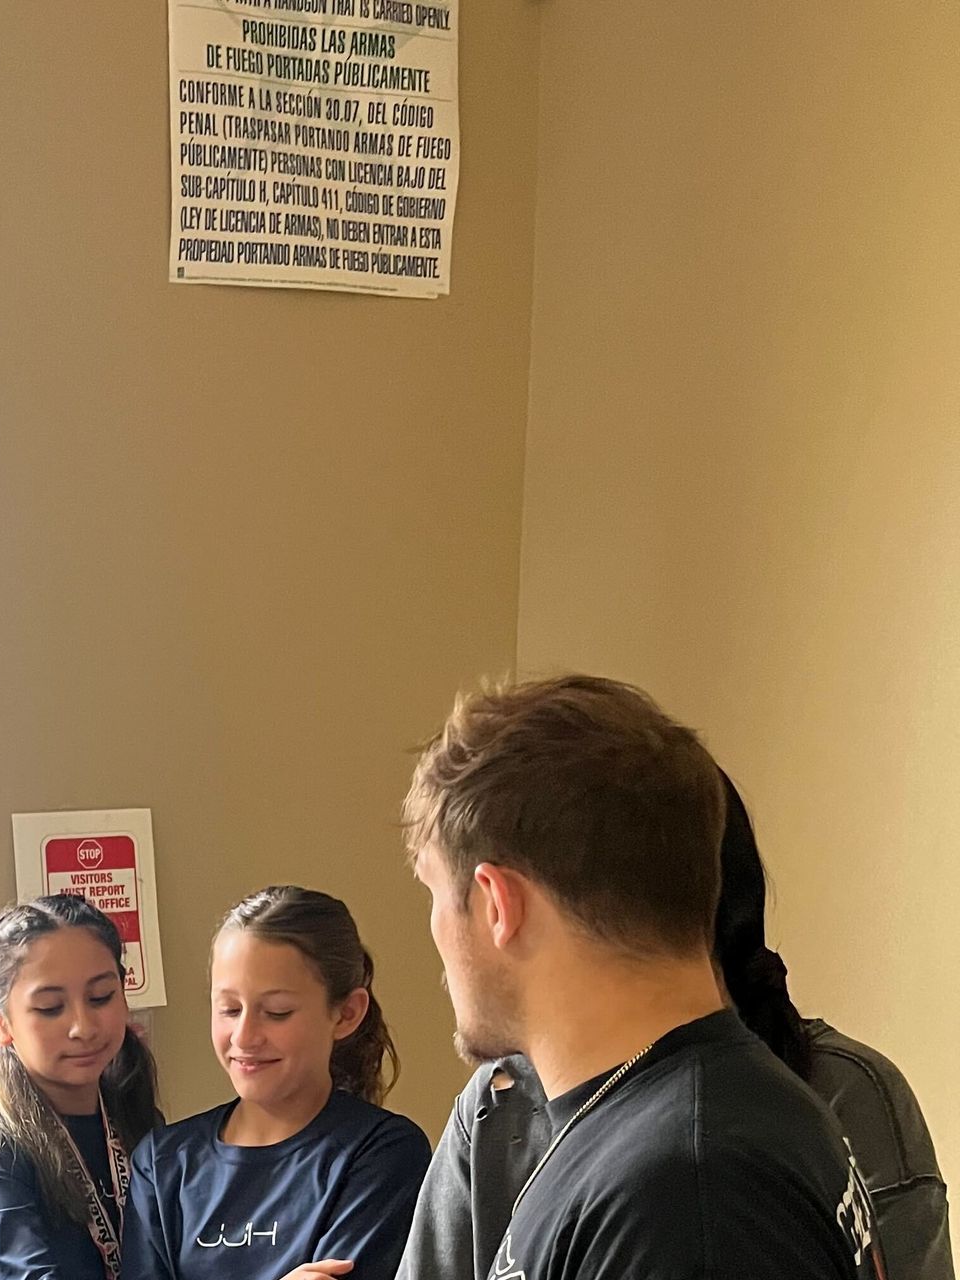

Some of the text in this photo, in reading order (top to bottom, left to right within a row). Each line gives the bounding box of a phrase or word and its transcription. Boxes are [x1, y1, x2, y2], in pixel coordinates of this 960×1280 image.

[360, 0, 370, 18] IS
[373, 0, 413, 24] CARRIED
[242, 19, 396, 59] PROHIBIDAS LAS ARMAS
[206, 43, 430, 93] DE FUEGO PORTADAS PÚBLICAMENTE
[179, 78, 434, 129] CONFORME A LA SECCIÓN 30.07, DEL CÓDIGO
[179, 111, 452, 160] PENAL (TRASPASAR PORTANDO ARMAS DE FUEGO
[180, 136, 447, 190] PÚBLICAMENTE) PERSONAS CON LICENCIA BAJO DEL
[180, 171, 446, 221] SUB-CAPÍTULO H, CAPÍTULO 411, CÓDIGO DE GOBIERNO
[180, 206, 203, 232] (LEY
[204, 207, 217, 231] DE
[220, 209, 266, 234] LICENCIA
[269, 212, 282, 235] DE
[326, 217, 340, 241] NO
[341, 219, 370, 244] DEBEN
[372, 222, 408, 247] ENTRAR
[410, 225, 418, 248] A
[419, 226, 441, 250] ESTA
[178, 238, 234, 264] PROPIEDAD
[237, 241, 291, 267] PORTANDO
[292, 244, 327, 269] ARMAS
[329, 247, 341, 270] DE
[342, 249, 369, 273] FUEGO
[79, 848, 101, 860] STOP
[70, 873, 113, 885] VISITORS
[89, 885, 126, 897] REPORT
[98, 897, 131, 909] OFFICE
